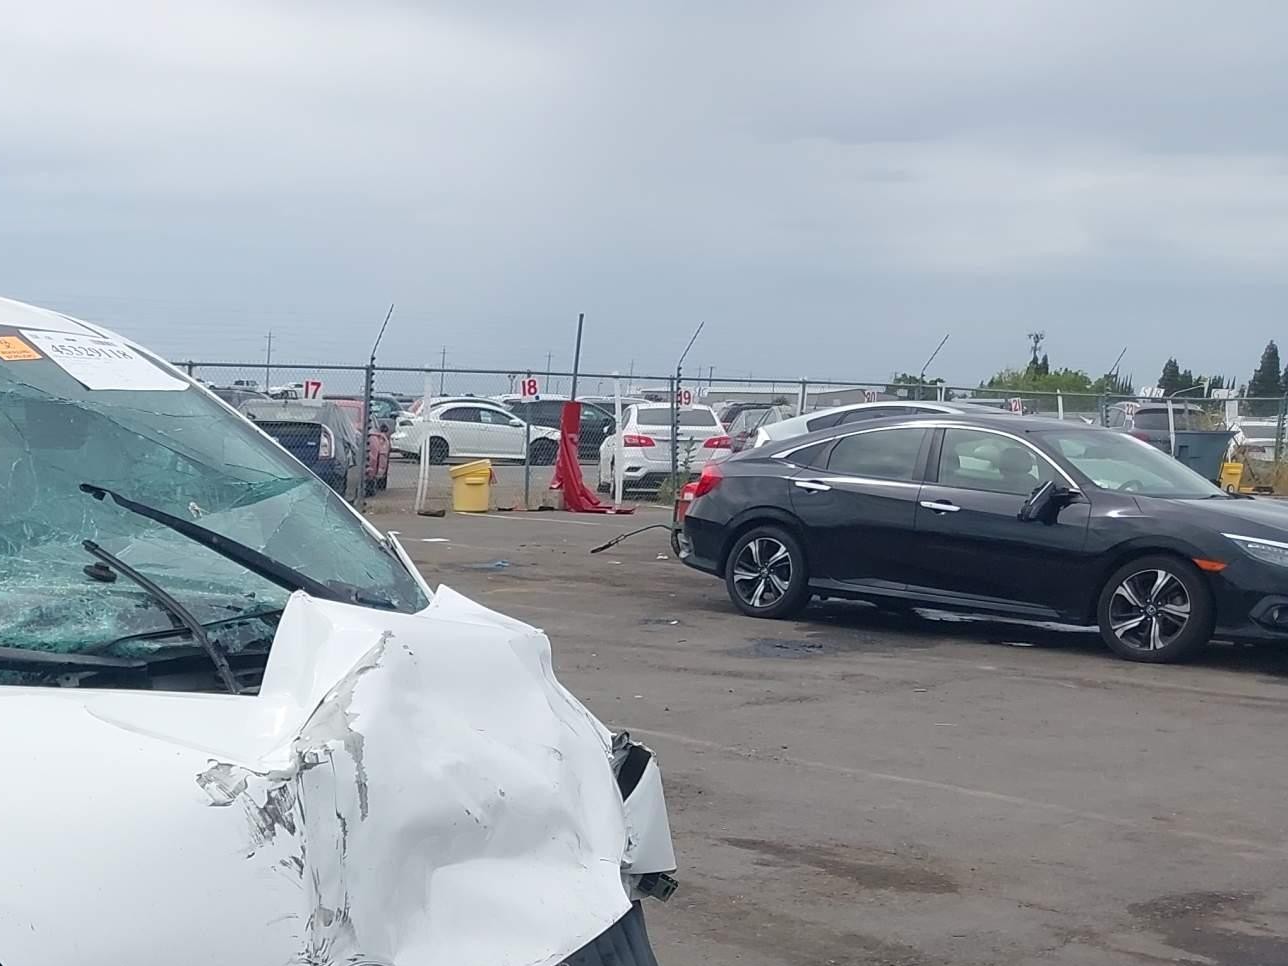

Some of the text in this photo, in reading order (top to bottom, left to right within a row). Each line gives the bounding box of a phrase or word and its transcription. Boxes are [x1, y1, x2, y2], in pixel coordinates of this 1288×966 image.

[305, 381, 321, 399] 17
[521, 379, 537, 396] 18
[679, 390, 691, 405] 19
